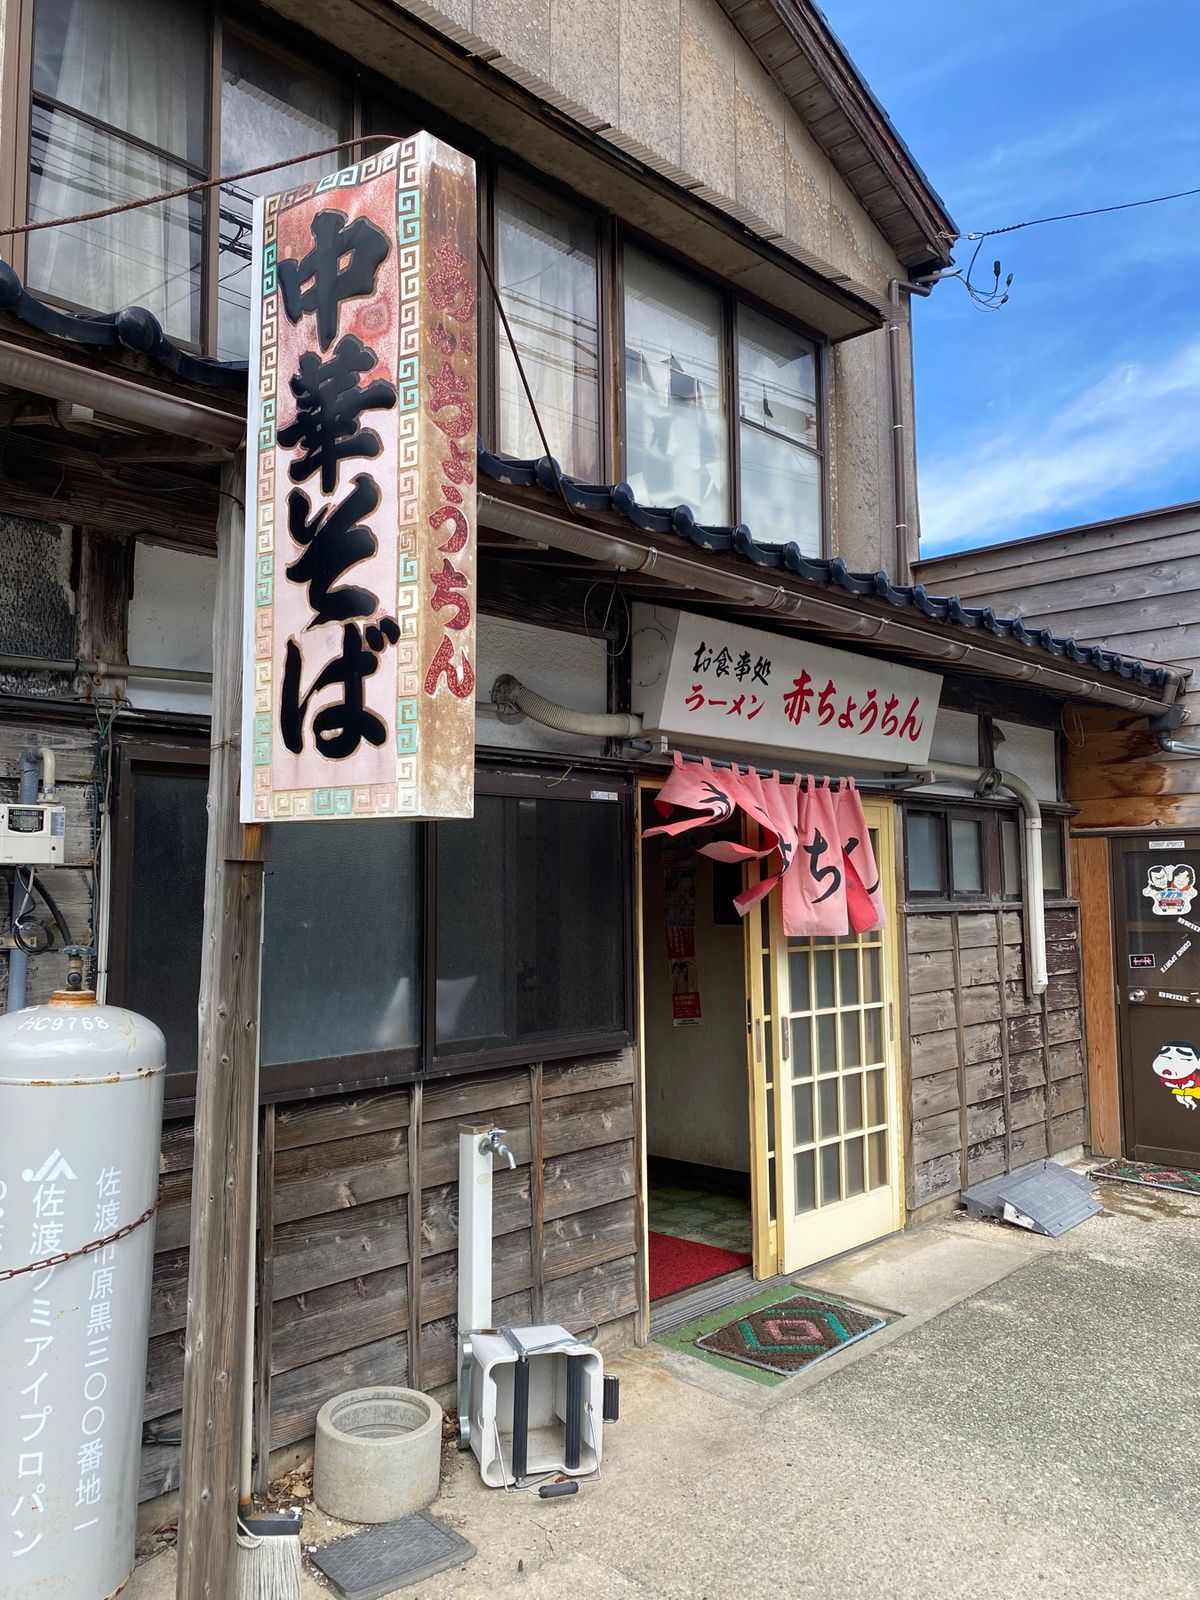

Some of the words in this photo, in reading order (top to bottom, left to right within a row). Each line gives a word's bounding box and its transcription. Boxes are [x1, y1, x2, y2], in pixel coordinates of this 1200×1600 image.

[277, 208, 400, 761] 中華そば
[692, 641, 772, 686] お食事処
[685, 685, 765, 720] ラーメン
[783, 669, 924, 742] 赤ちょうちん
[1158, 991, 1190, 1003] BRIDE
[18, 1015, 110, 1031] HC9768
